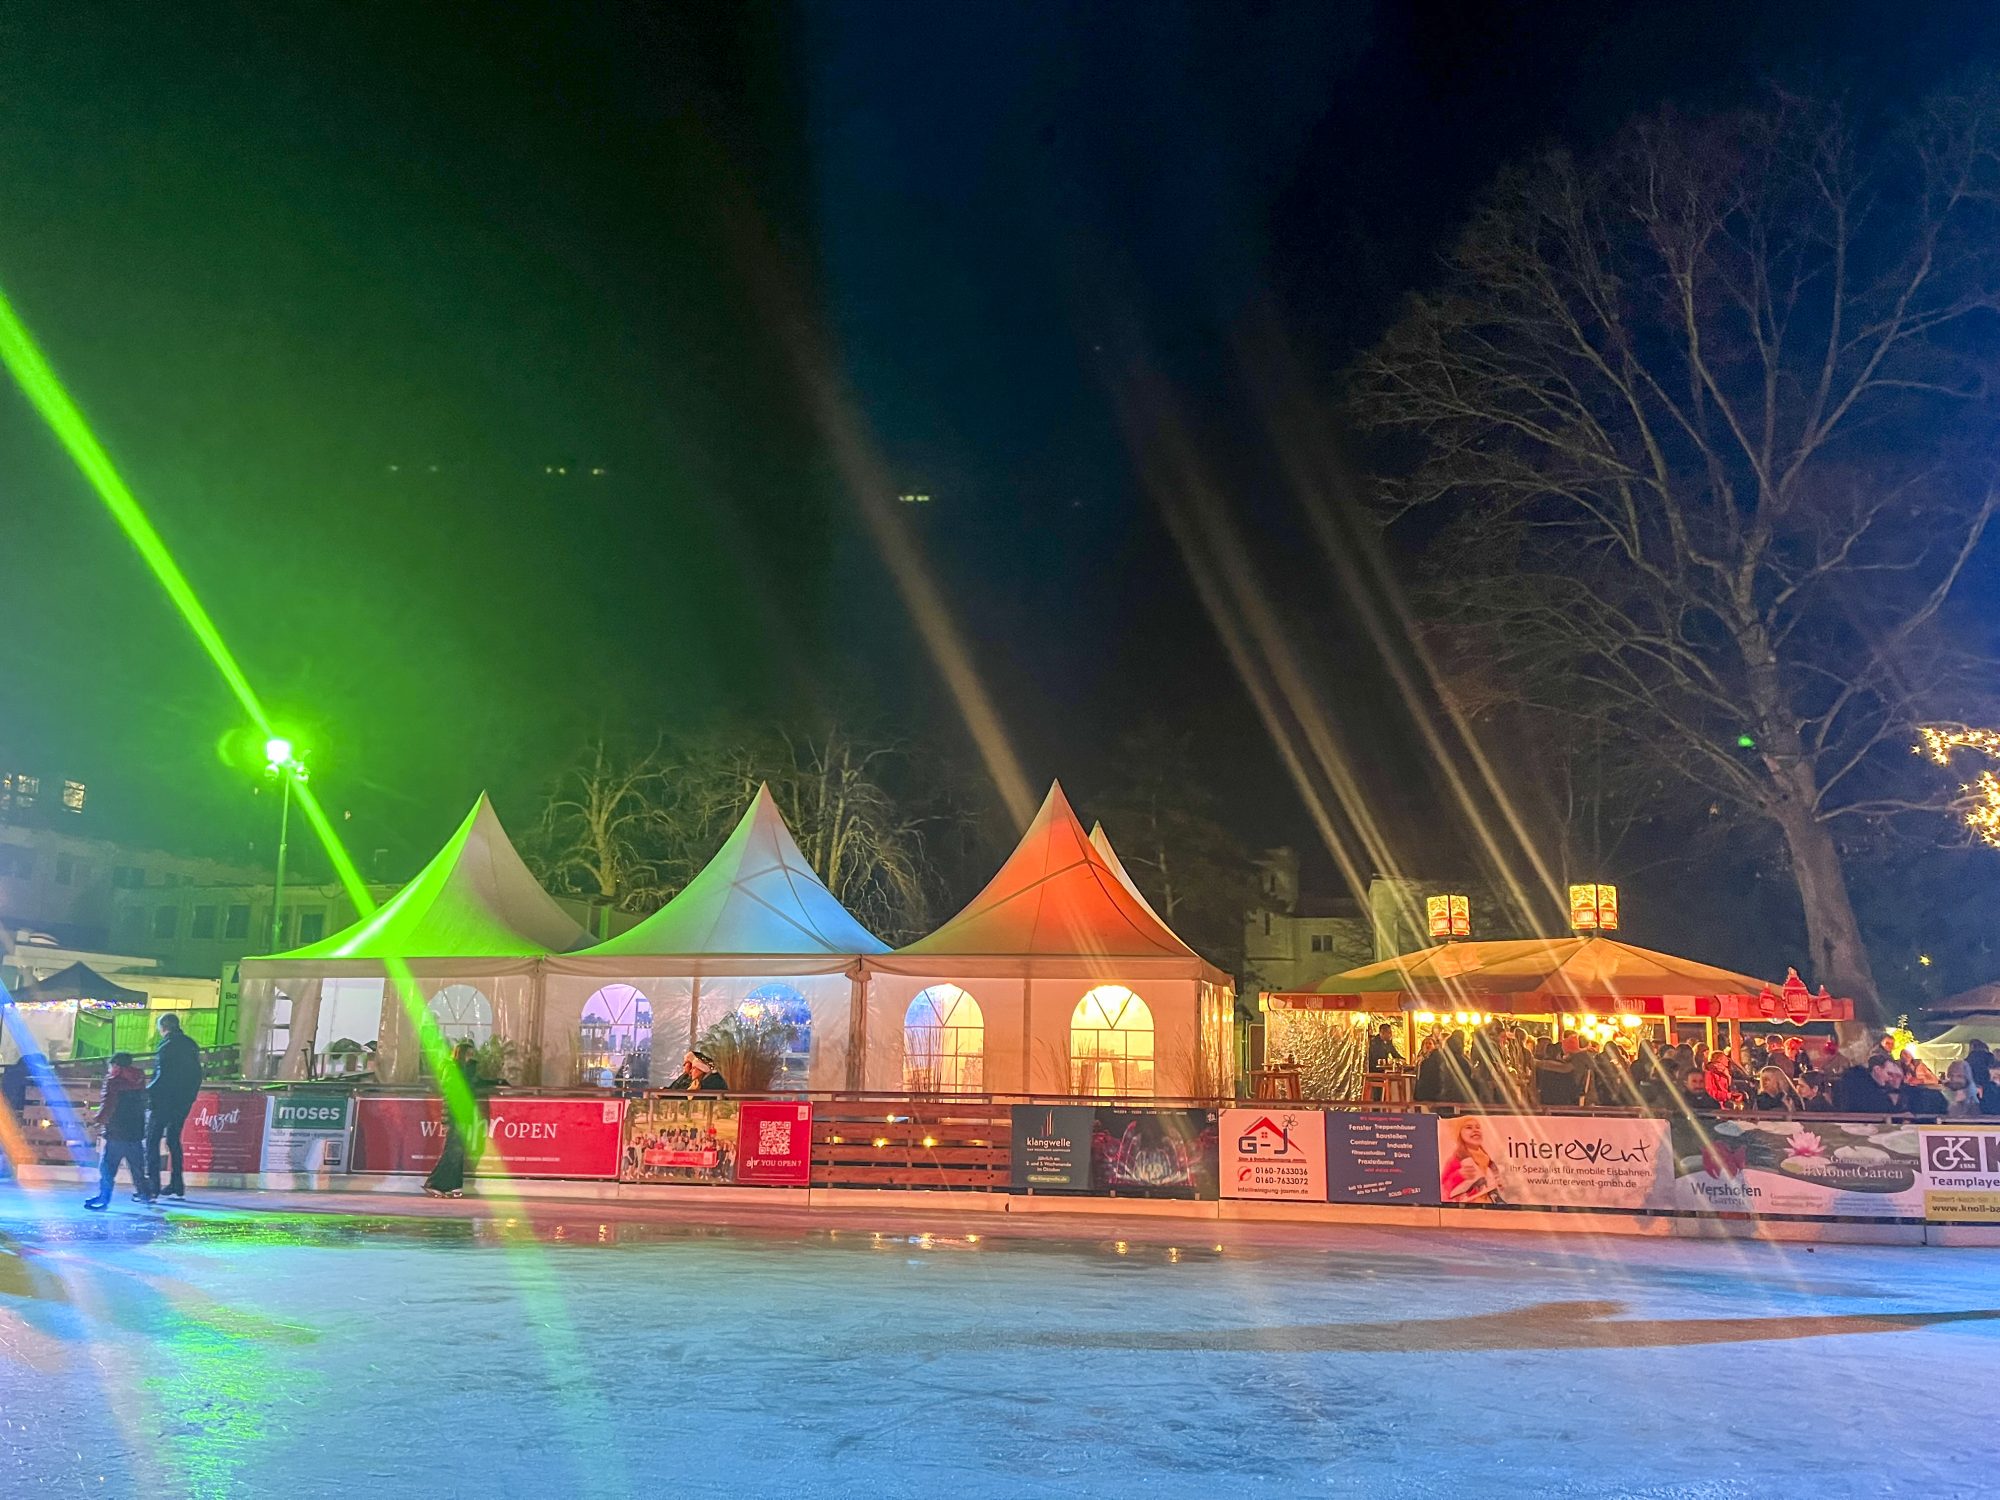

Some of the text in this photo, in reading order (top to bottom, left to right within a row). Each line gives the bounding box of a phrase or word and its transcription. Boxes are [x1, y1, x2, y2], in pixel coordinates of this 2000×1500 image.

[194, 1107, 240, 1131] Auszeit
[279, 1107, 340, 1120] moses
[504, 1123, 557, 1139] OPEN
[1026, 1137, 1071, 1149] klangwelle
[1238, 1128, 1288, 1154] G-J
[1255, 1167, 1308, 1175] 0160-7633036
[1562, 1166, 1574, 1175] für
[1576, 1167, 1605, 1175] mobile
[1607, 1168, 1652, 1177] Eisbahnen.
[1255, 1177, 1309, 1185] 0160-7633072
[1527, 1178, 1637, 1189] www.interevent-gmbh.de
[1691, 1182, 1762, 1197] Wershofen
